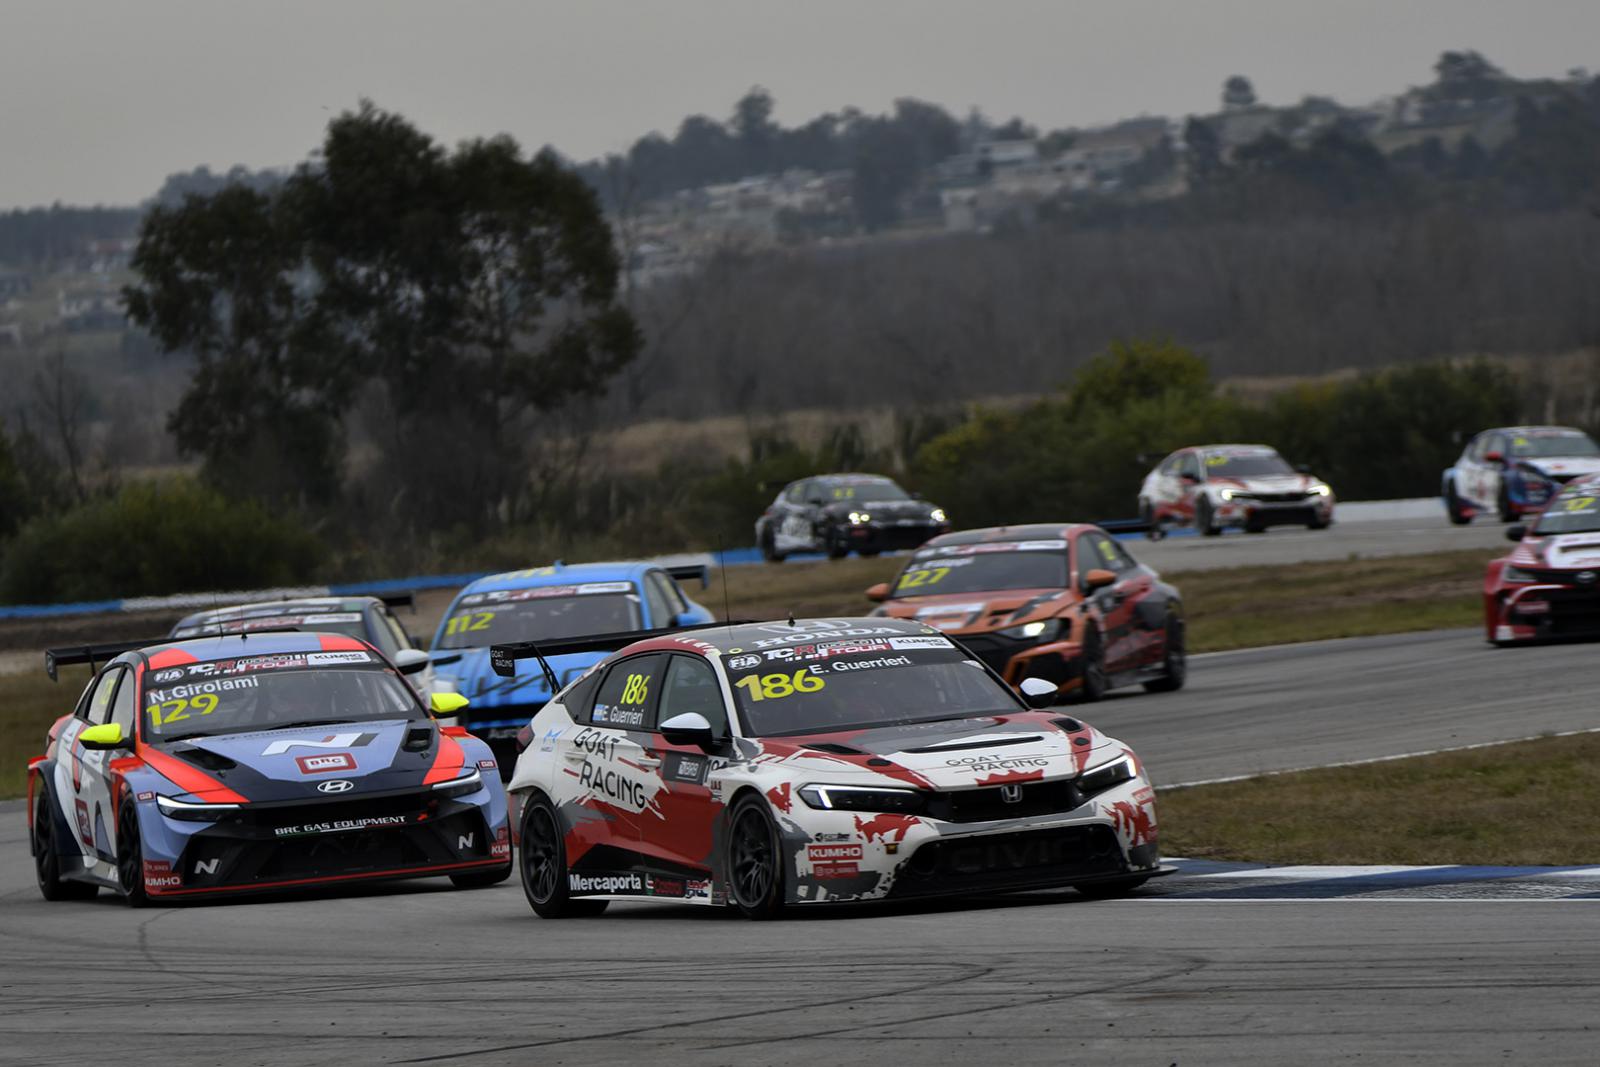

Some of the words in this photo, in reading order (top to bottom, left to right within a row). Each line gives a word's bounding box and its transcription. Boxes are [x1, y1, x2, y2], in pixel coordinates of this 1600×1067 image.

[445, 612, 495, 636] 112
[752, 627, 907, 648] HONDA
[729, 656, 760, 668] FIA
[763, 644, 816, 661] TCR
[833, 644, 887, 655] TOUR
[809, 664, 830, 675] E.
[832, 655, 911, 671] Guerrieri
[155, 670, 183, 682] FIA
[734, 669, 826, 702] 186
[620, 673, 651, 705] 186
[146, 693, 220, 728] 129
[610, 705, 644, 725] Guerrieri
[574, 727, 620, 762] GOAT
[310, 757, 343, 766] BRC
[946, 754, 1001, 766] GOAT
[970, 758, 1049, 772] RACING
[579, 760, 646, 809] RACING
[274, 825, 301, 836] BRC
[303, 822, 331, 833] GAS
[333, 815, 407, 829] EQUIPMENT
[809, 847, 862, 858] KUMHO
[569, 873, 642, 893] Mercaporta
